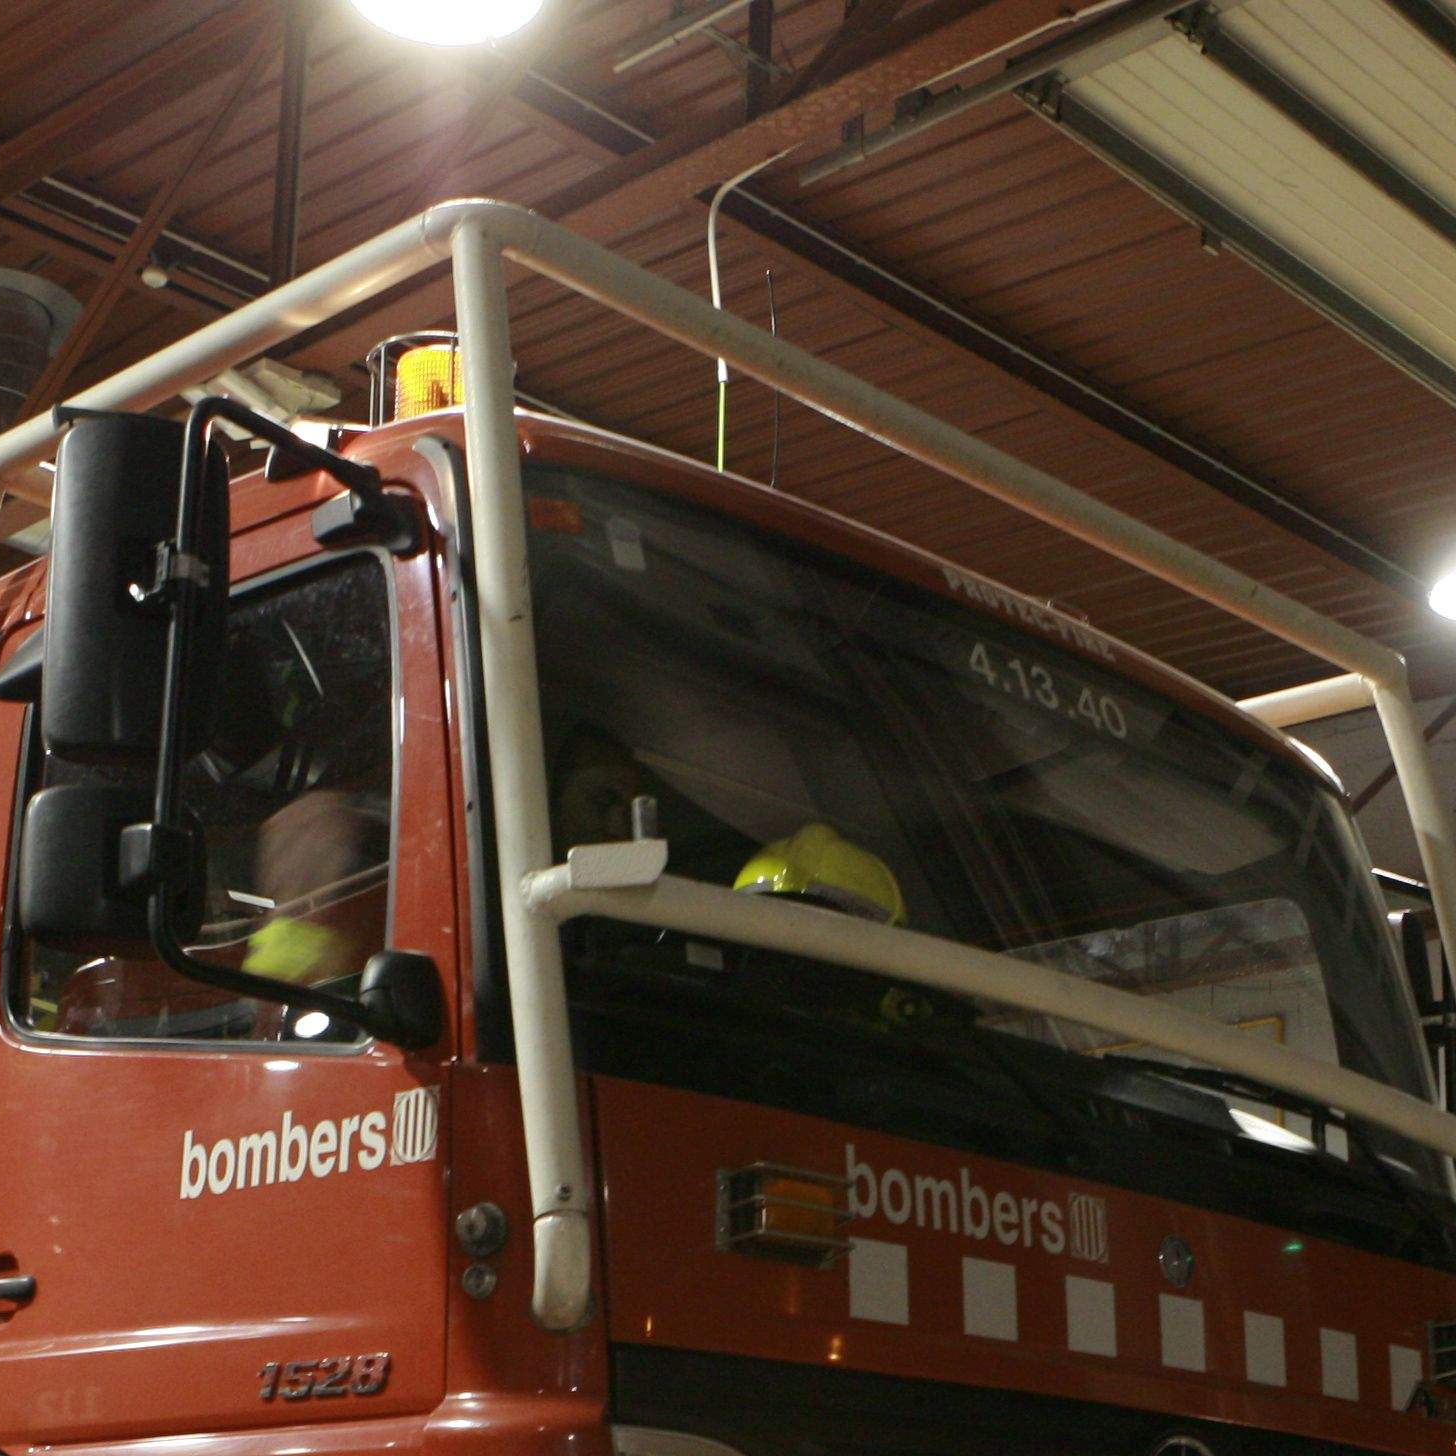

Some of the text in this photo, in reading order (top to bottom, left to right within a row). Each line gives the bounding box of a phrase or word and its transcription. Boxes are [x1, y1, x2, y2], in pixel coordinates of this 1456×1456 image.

[969, 642, 1128, 740] 4.13.40
[180, 1110, 387, 1200] bombers
[845, 1142, 1066, 1255] bombers
[256, 1351, 392, 1401] 1528
